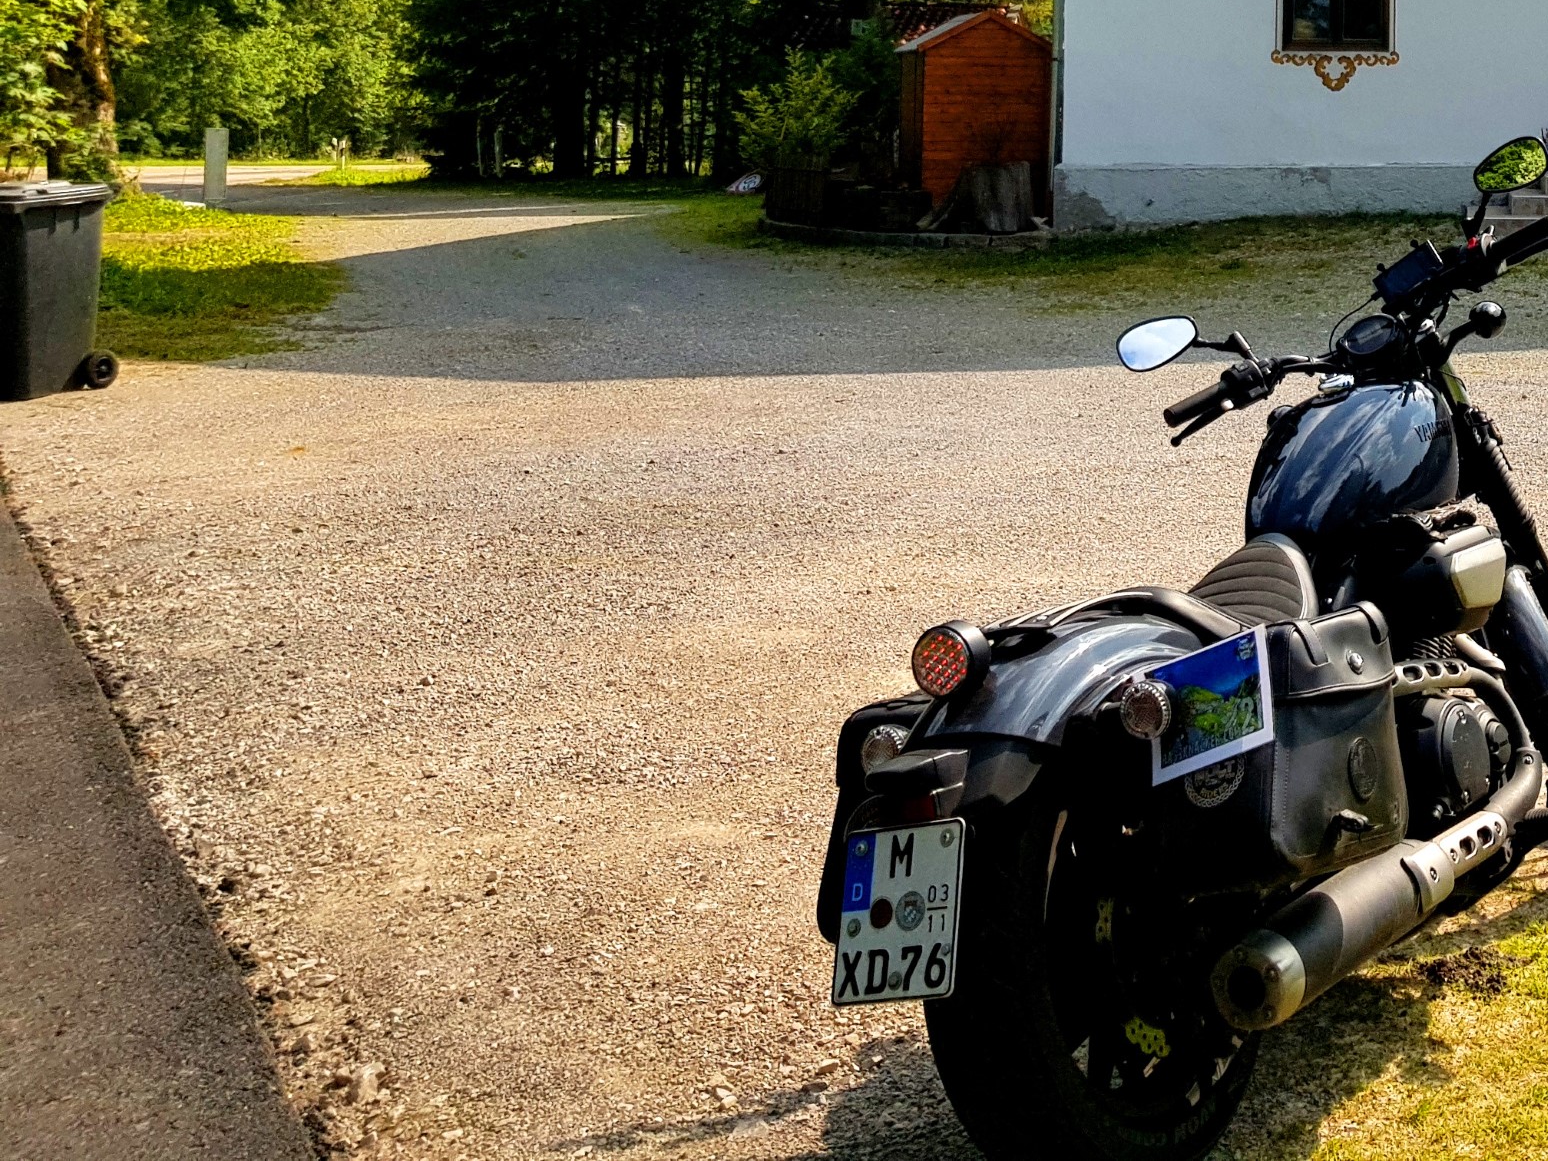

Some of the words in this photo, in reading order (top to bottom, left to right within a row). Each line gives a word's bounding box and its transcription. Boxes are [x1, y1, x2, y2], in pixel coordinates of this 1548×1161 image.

[889, 832, 915, 879] M
[851, 883, 863, 902] D
[927, 884, 949, 903] 03
[928, 914, 946, 933] 11
